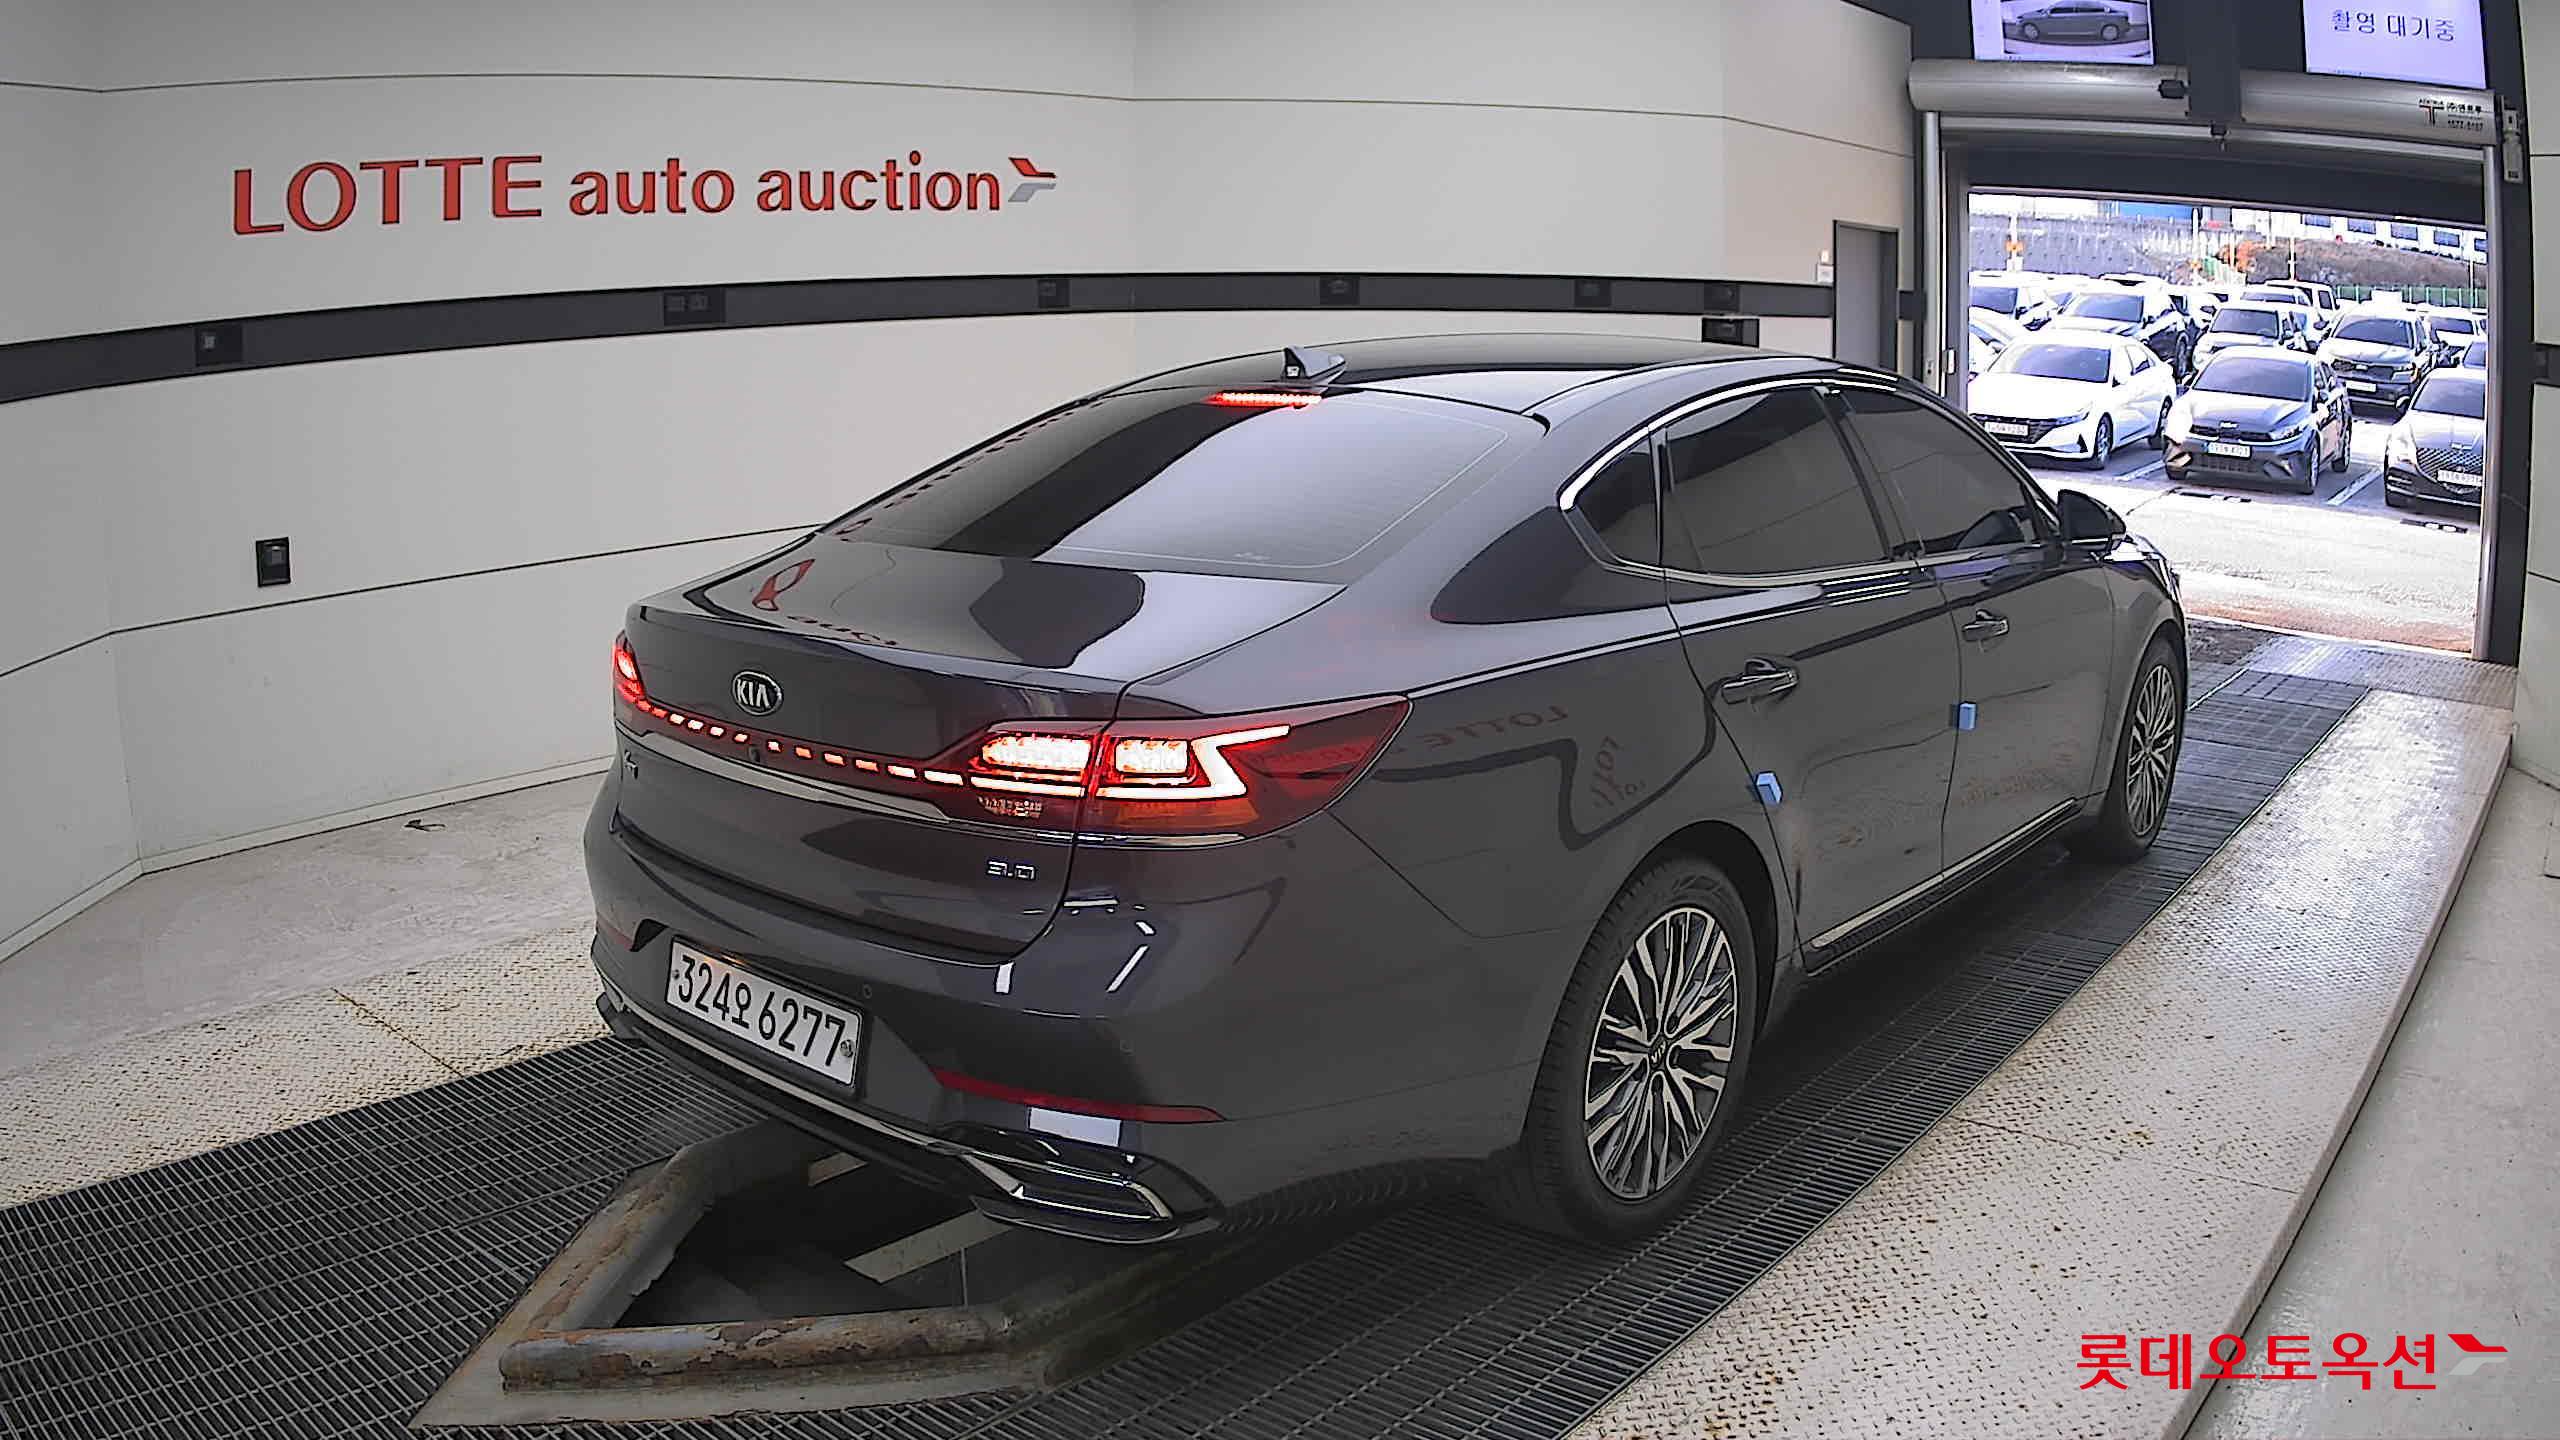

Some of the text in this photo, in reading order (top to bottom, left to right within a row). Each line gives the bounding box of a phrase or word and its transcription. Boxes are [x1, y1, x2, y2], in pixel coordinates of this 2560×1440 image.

[2331, 9, 2455, 42] 촬영 대기중
[234, 152, 1002, 235] LOTTE auto auction
[736, 678, 771, 709] KIA
[678, 954, 847, 1067] 324오 6277
